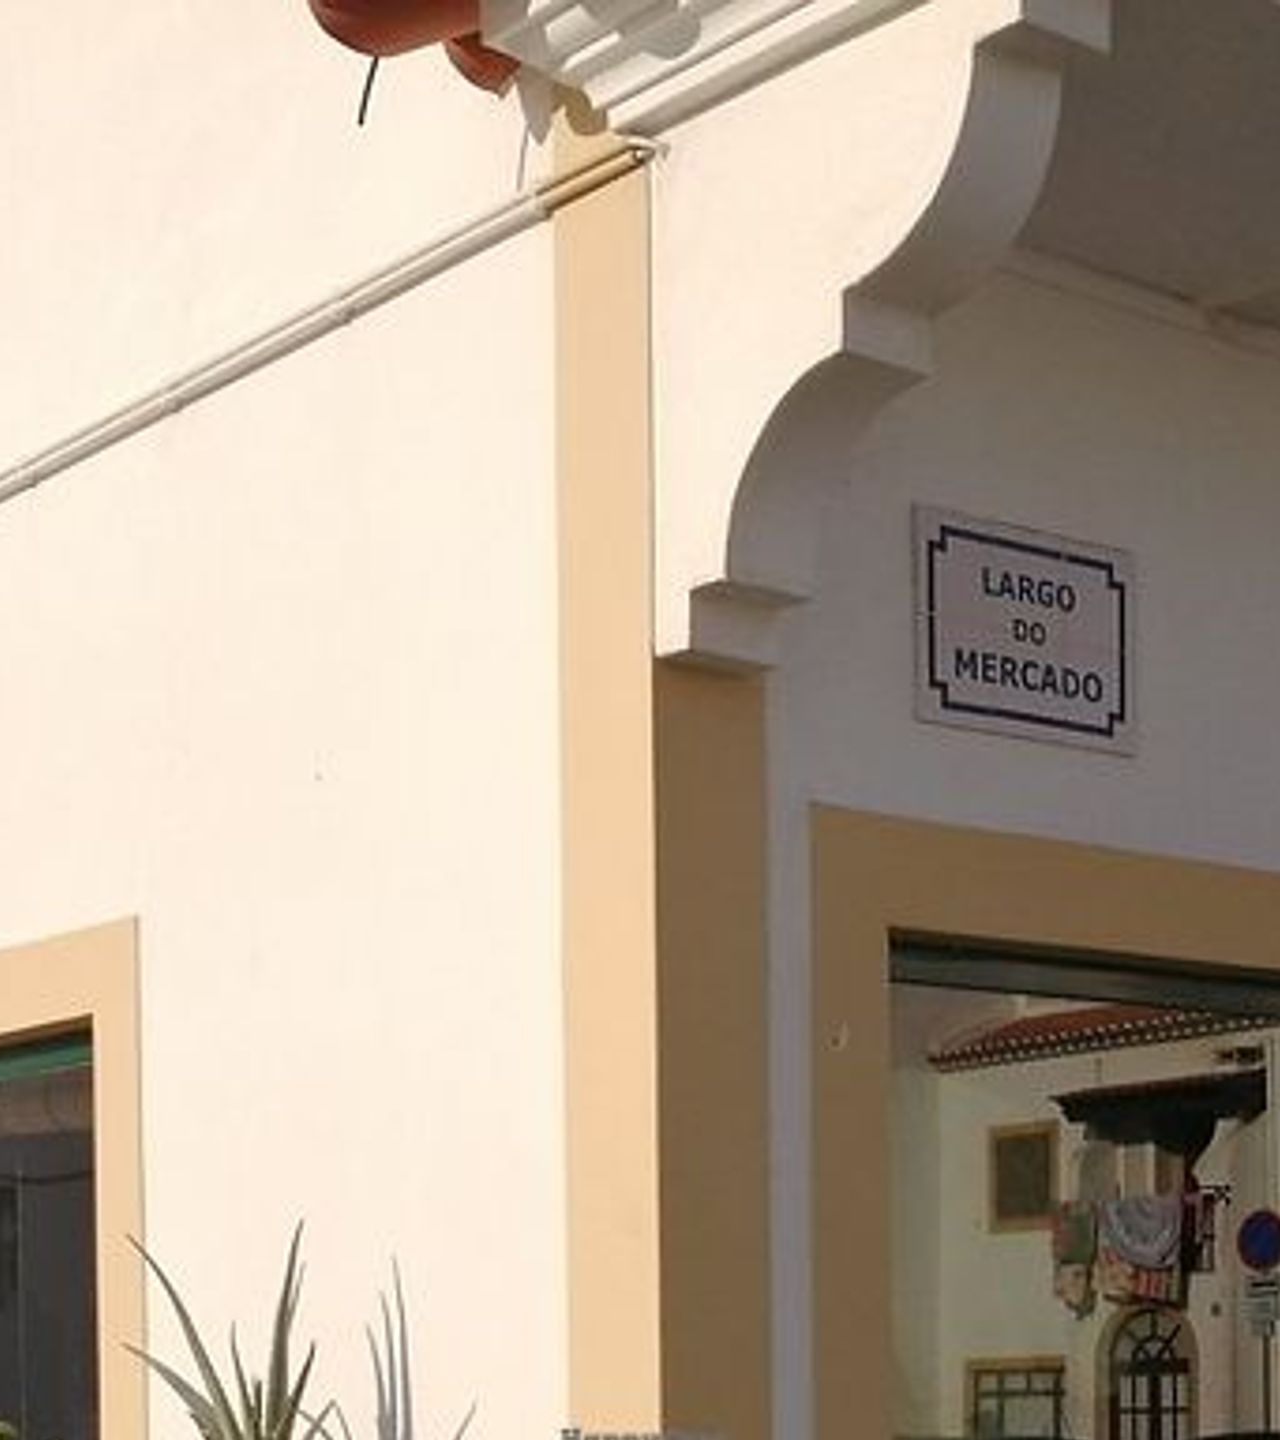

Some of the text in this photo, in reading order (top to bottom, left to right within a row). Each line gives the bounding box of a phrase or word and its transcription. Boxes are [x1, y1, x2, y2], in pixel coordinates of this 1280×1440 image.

[981, 566, 1077, 613] LARGO
[1013, 617, 1047, 647] DO
[954, 648, 1104, 704] MERCADO
